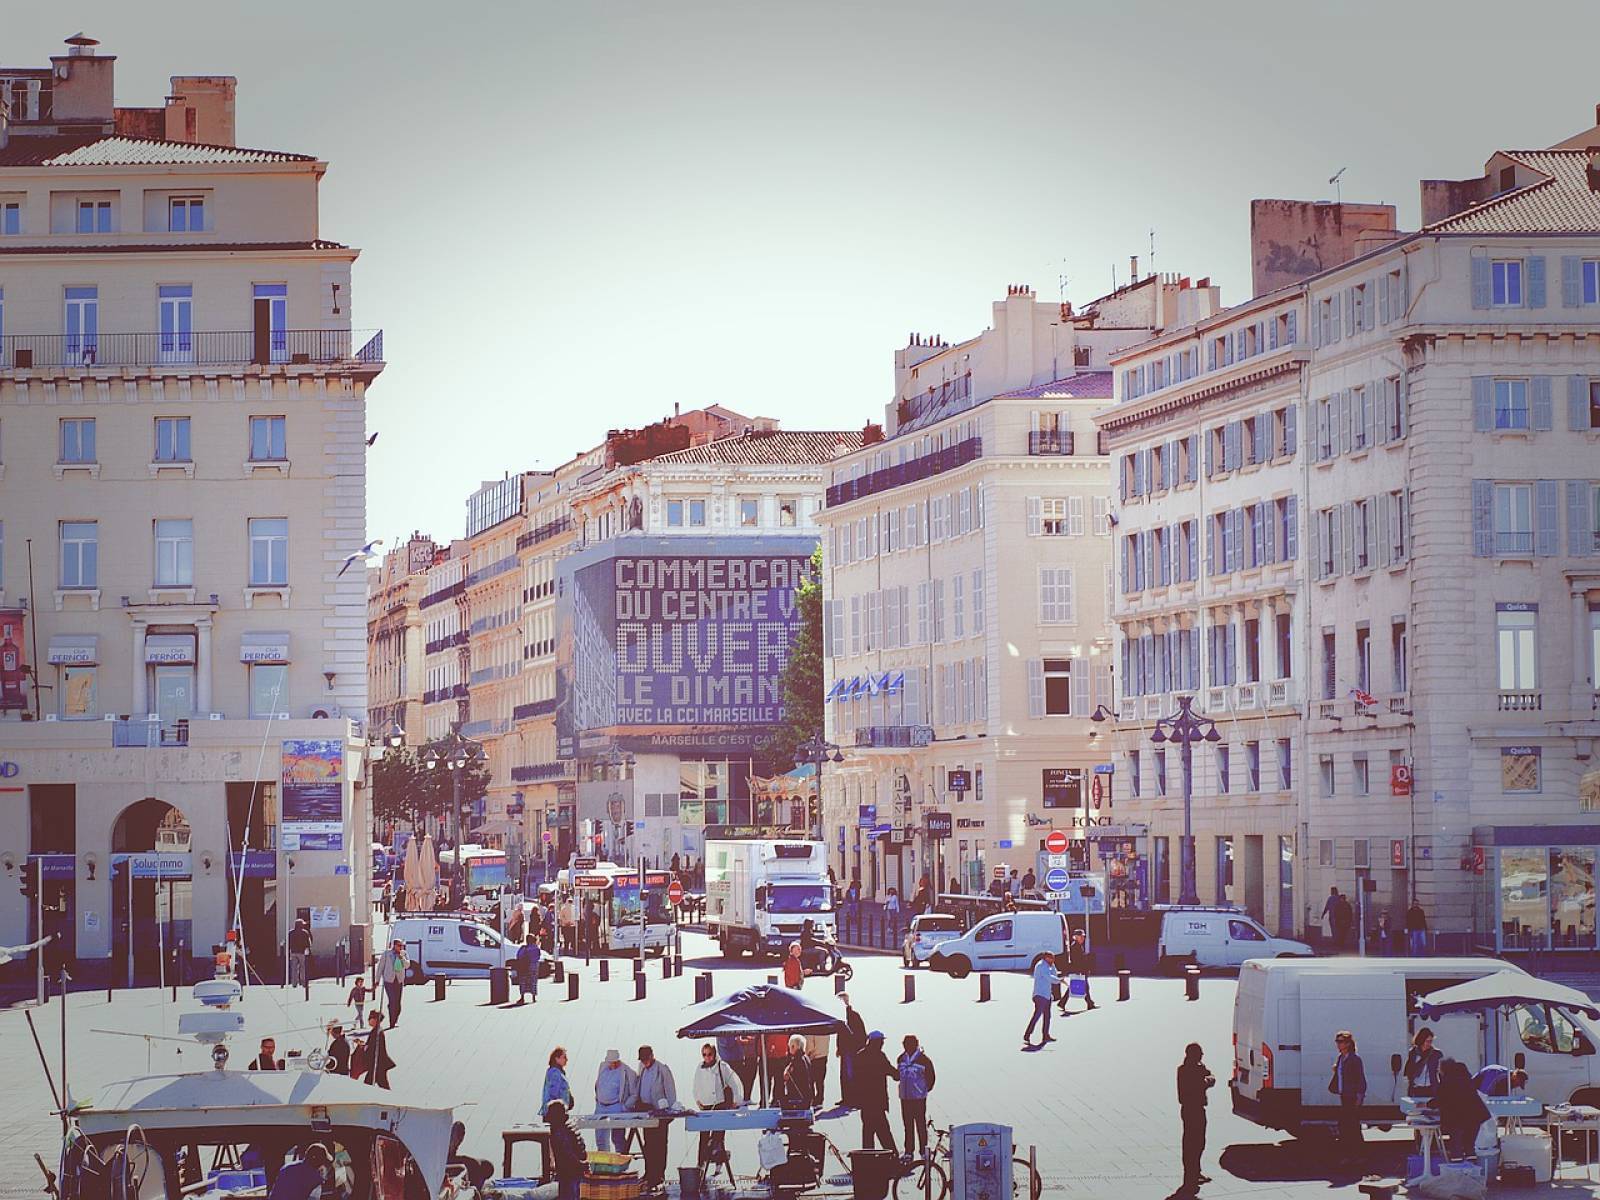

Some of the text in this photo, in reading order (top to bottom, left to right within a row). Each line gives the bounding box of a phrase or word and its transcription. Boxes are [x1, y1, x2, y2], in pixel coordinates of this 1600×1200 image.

[615, 590, 650, 619] DU
[662, 590, 768, 619] CENTRE
[1507, 603, 1529, 611] Quick
[616, 675, 653, 704] LE
[617, 707, 652, 723] AVEC
[657, 707, 673, 723] LA
[677, 707, 698, 723] CCI
[704, 707, 773, 722] MARSEILLE
[652, 735, 715, 746] MARSEILLE
[719, 734, 750, 745] C'EST
[1510, 747, 1532, 755] Quick
[894, 766, 904, 840] CHANGE
[929, 819, 950, 830] Métro
[134, 858, 183, 869] Solucmmo
[617, 876, 627, 887] 57
